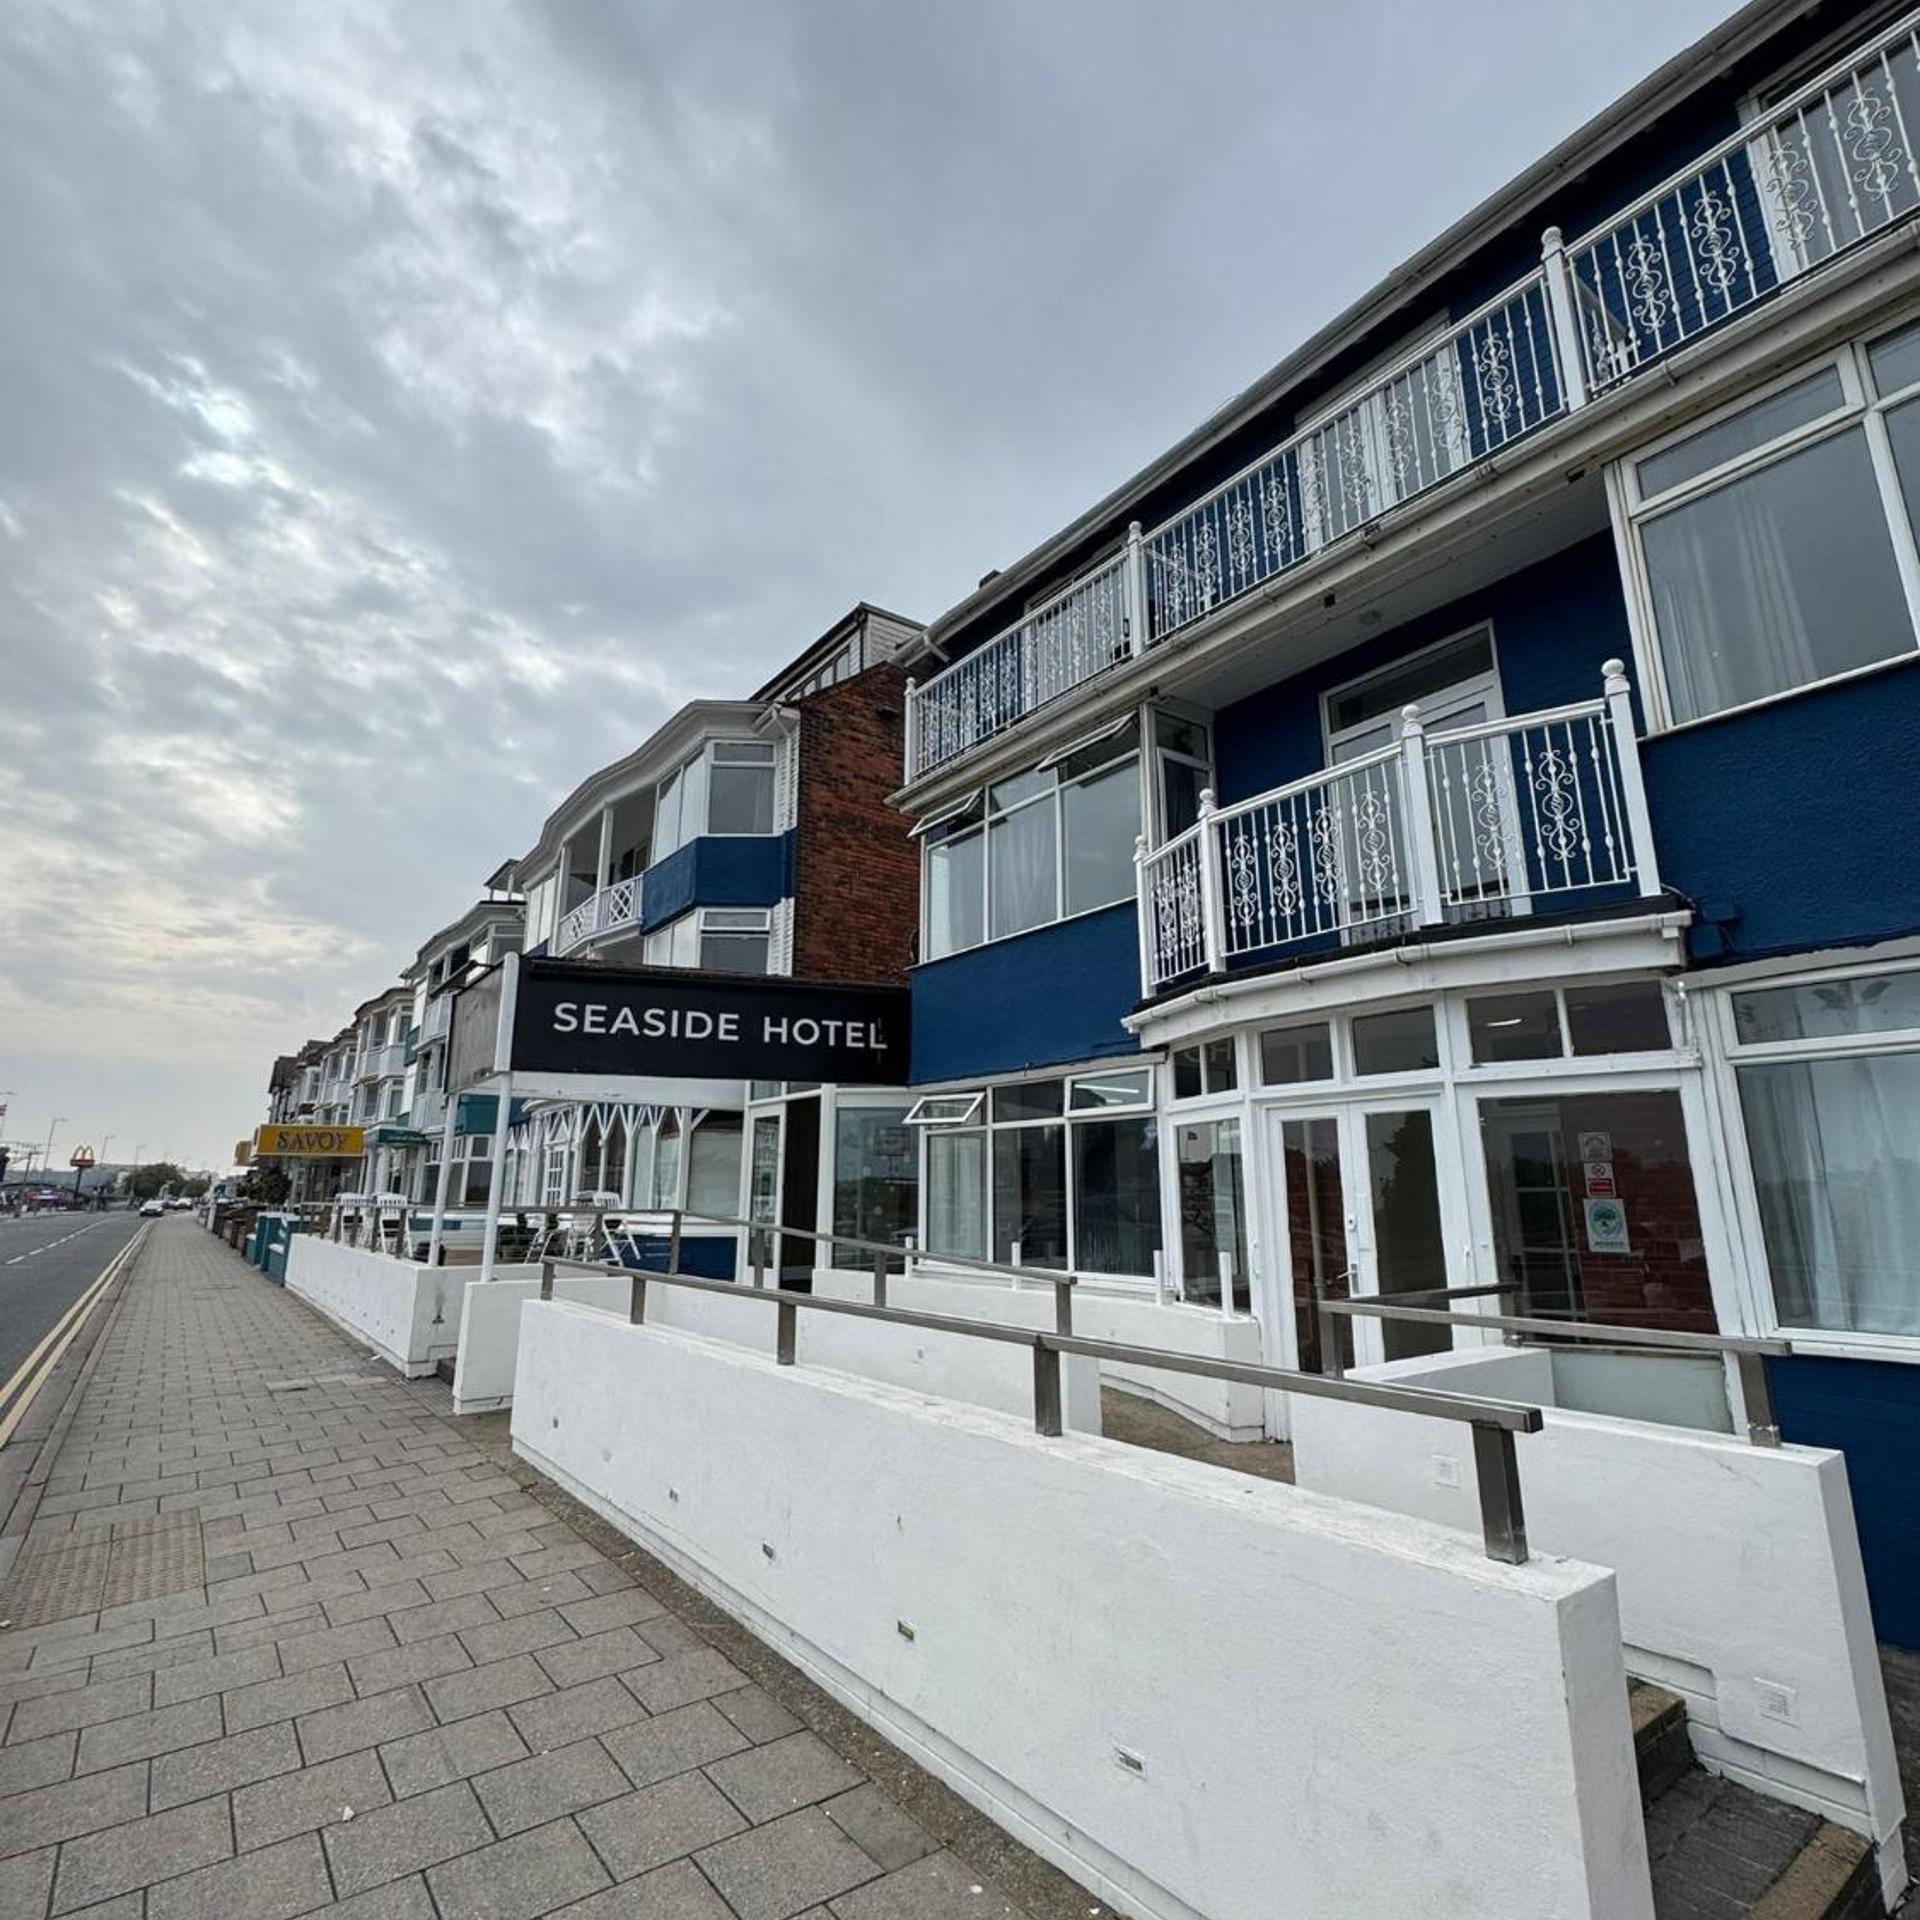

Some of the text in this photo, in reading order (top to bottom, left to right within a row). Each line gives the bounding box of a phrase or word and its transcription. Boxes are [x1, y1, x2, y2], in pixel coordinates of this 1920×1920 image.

[552, 1002, 888, 1049] SEASIDE HOTEL
[277, 1131, 351, 1152] SAVOY
